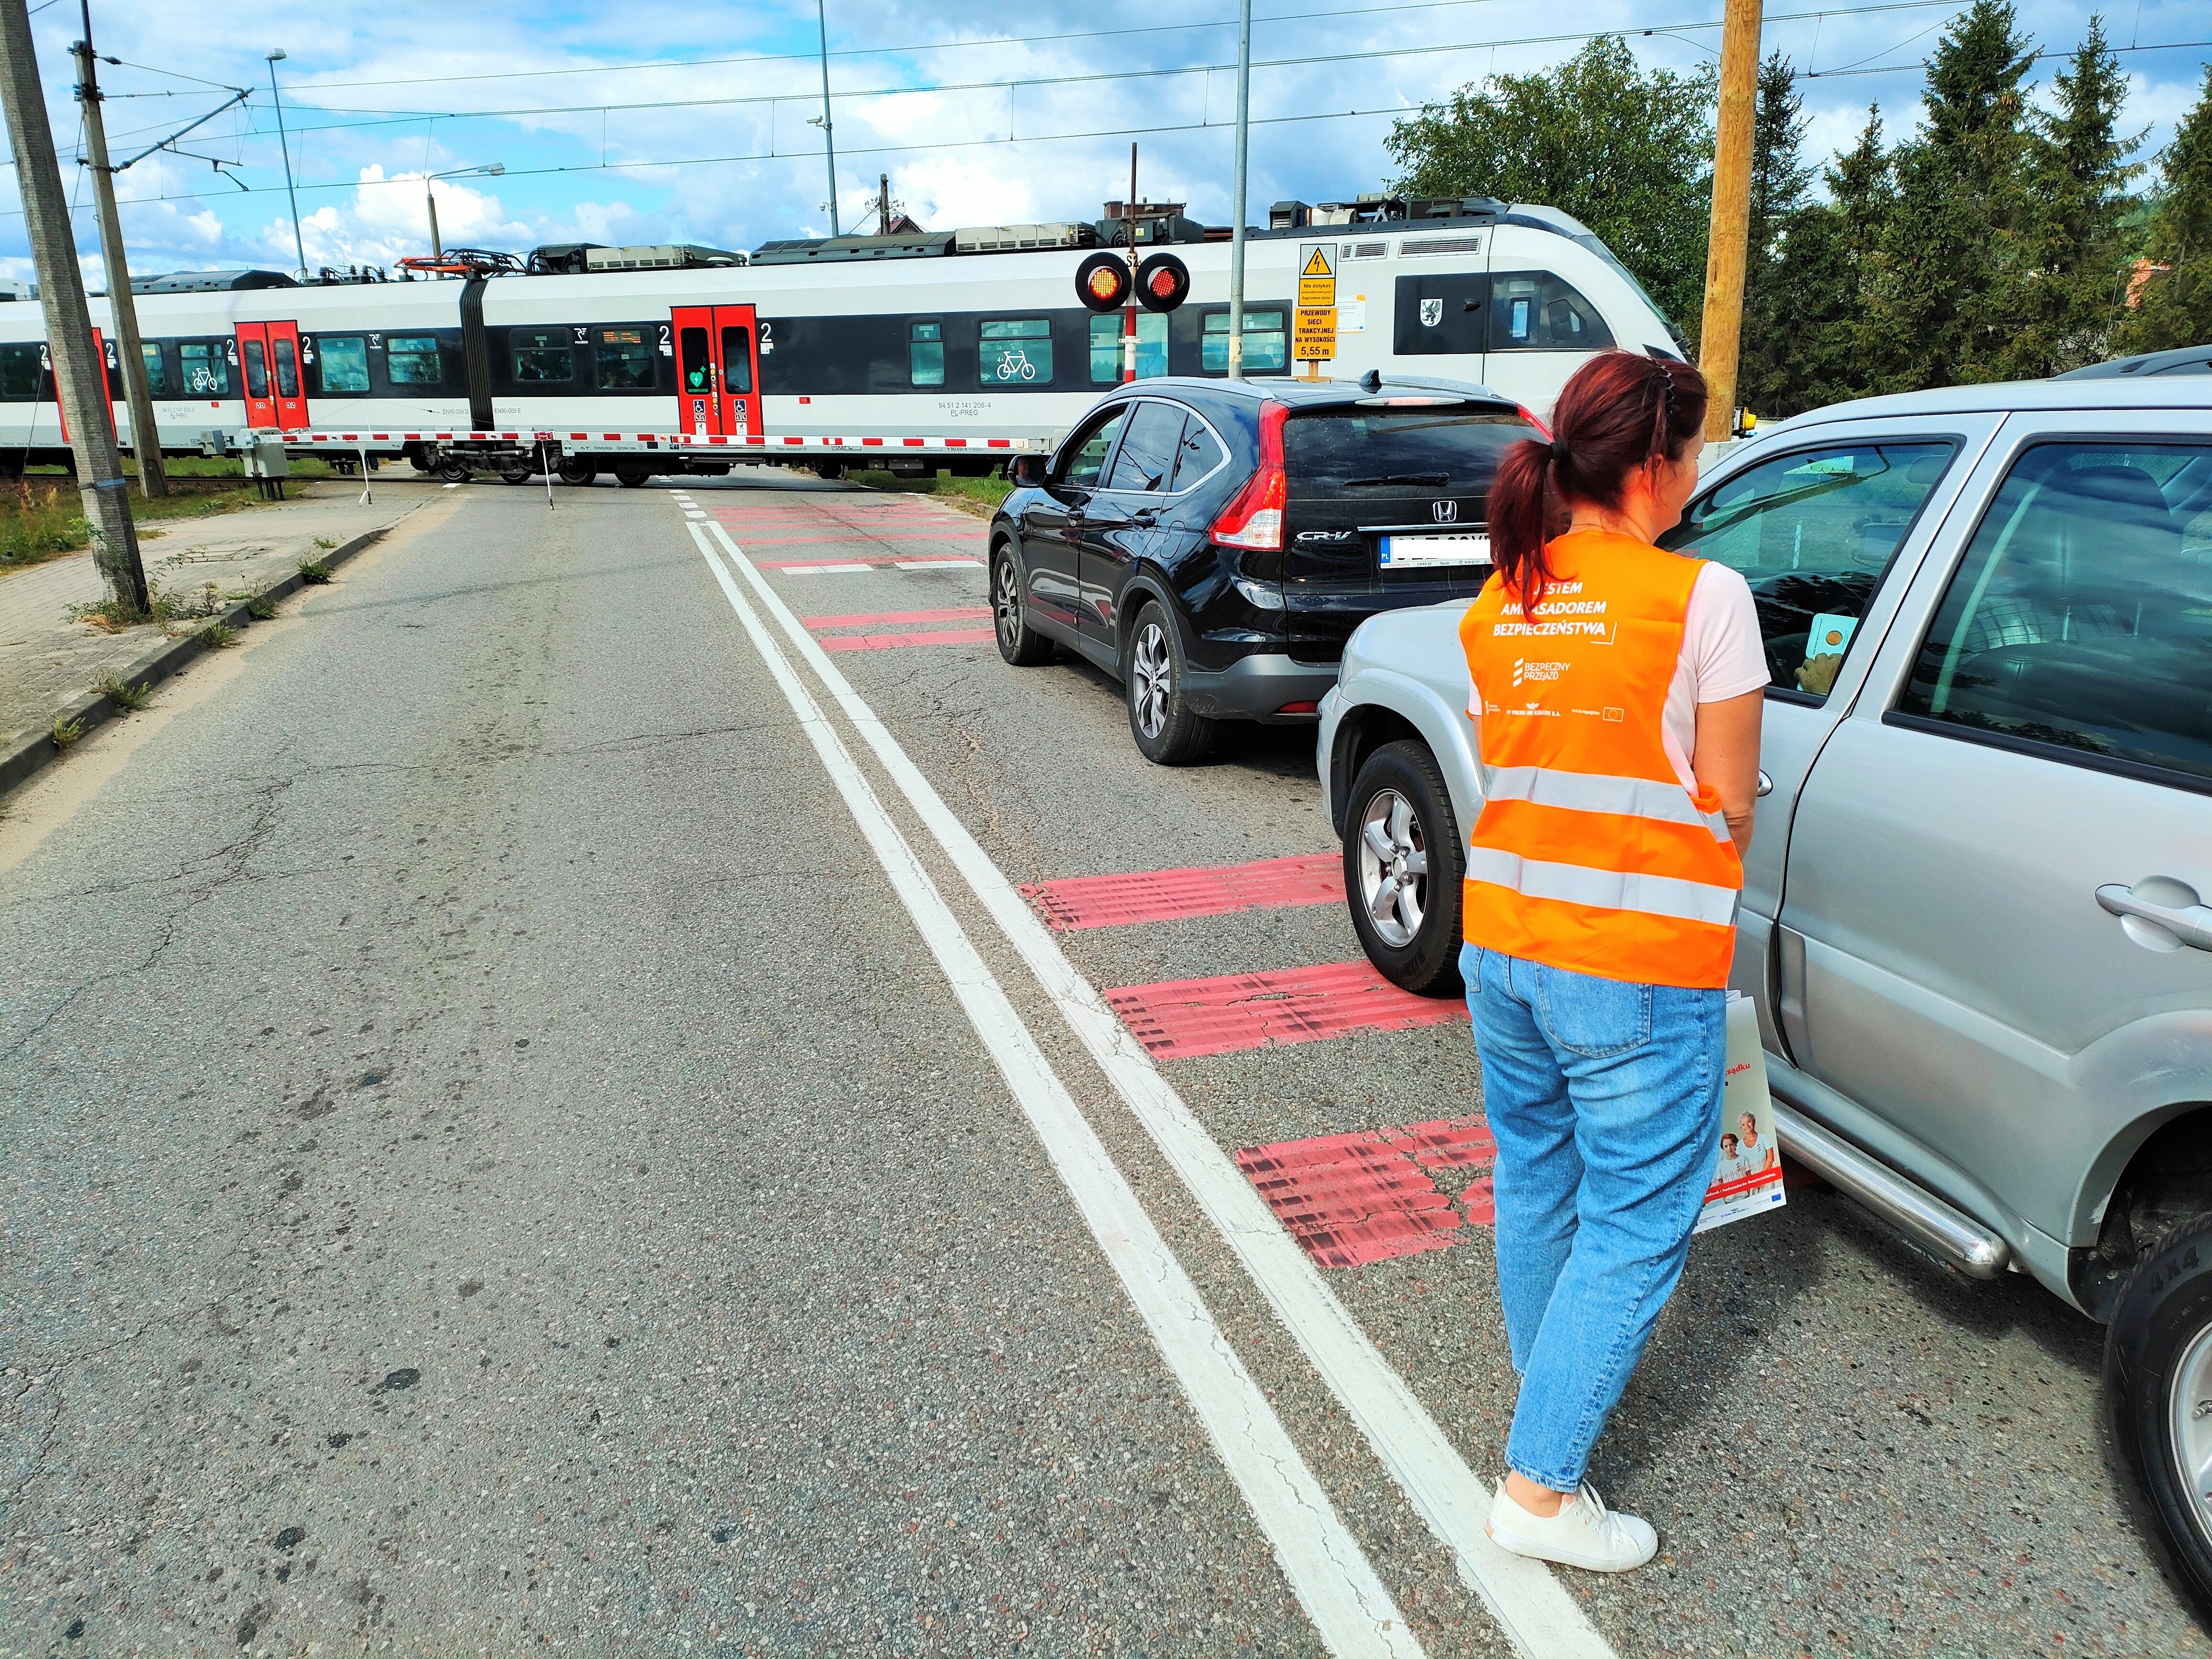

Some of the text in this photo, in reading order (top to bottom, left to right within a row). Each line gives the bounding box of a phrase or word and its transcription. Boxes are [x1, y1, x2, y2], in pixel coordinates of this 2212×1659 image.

[1127, 255, 1139, 267] S2
[659, 325, 670, 344] 2
[761, 322, 773, 343] 2
[40, 344, 48, 360] 2
[105, 343, 115, 358] 2
[226, 339, 236, 355] 2
[303, 336, 312, 353] 2
[1301, 346, 1320, 357] 5,55
[1296, 531, 1352, 541] CR-V
[1500, 601, 1607, 616] AMASADOREM
[1493, 619, 1606, 637] BEZPIECZEŃSTWA
[1524, 671, 1559, 682] PRZEJAZD
